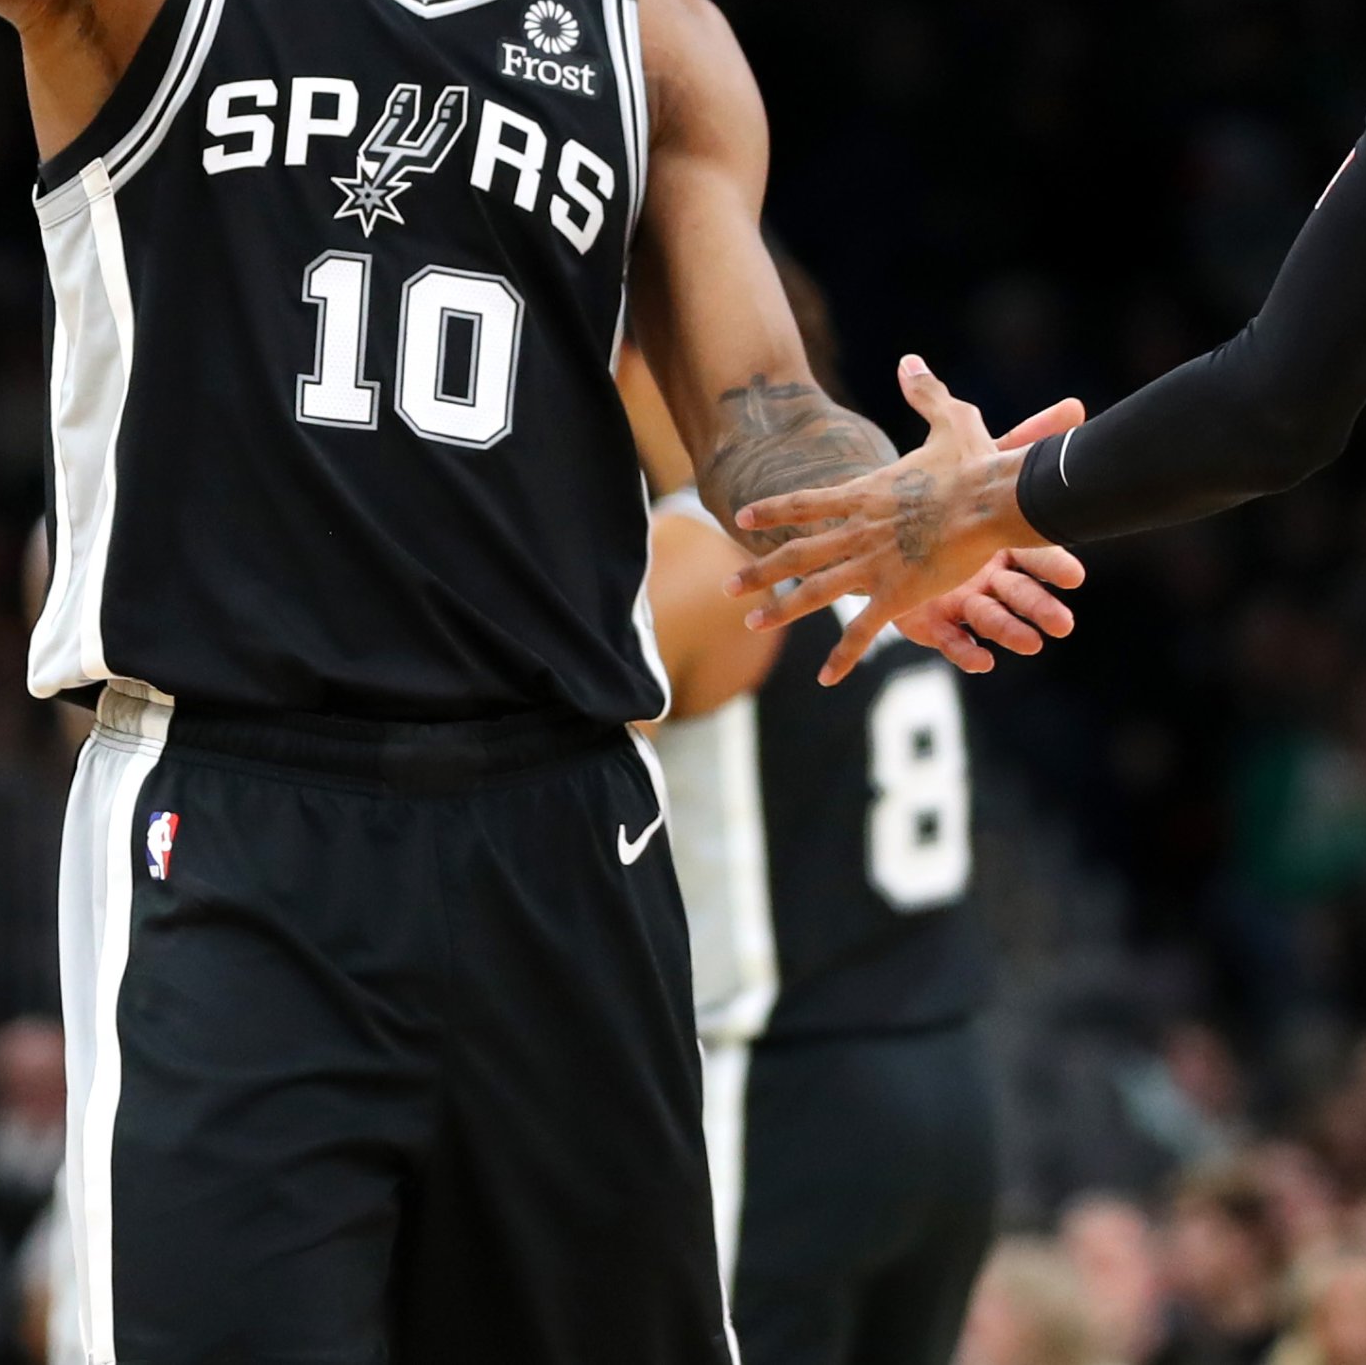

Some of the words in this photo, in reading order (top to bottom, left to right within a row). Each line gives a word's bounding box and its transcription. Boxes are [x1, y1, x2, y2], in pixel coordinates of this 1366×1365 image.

[501, 42, 596, 96] Frost
[296, 249, 524, 450] 10
[867, 661, 972, 913] 8
